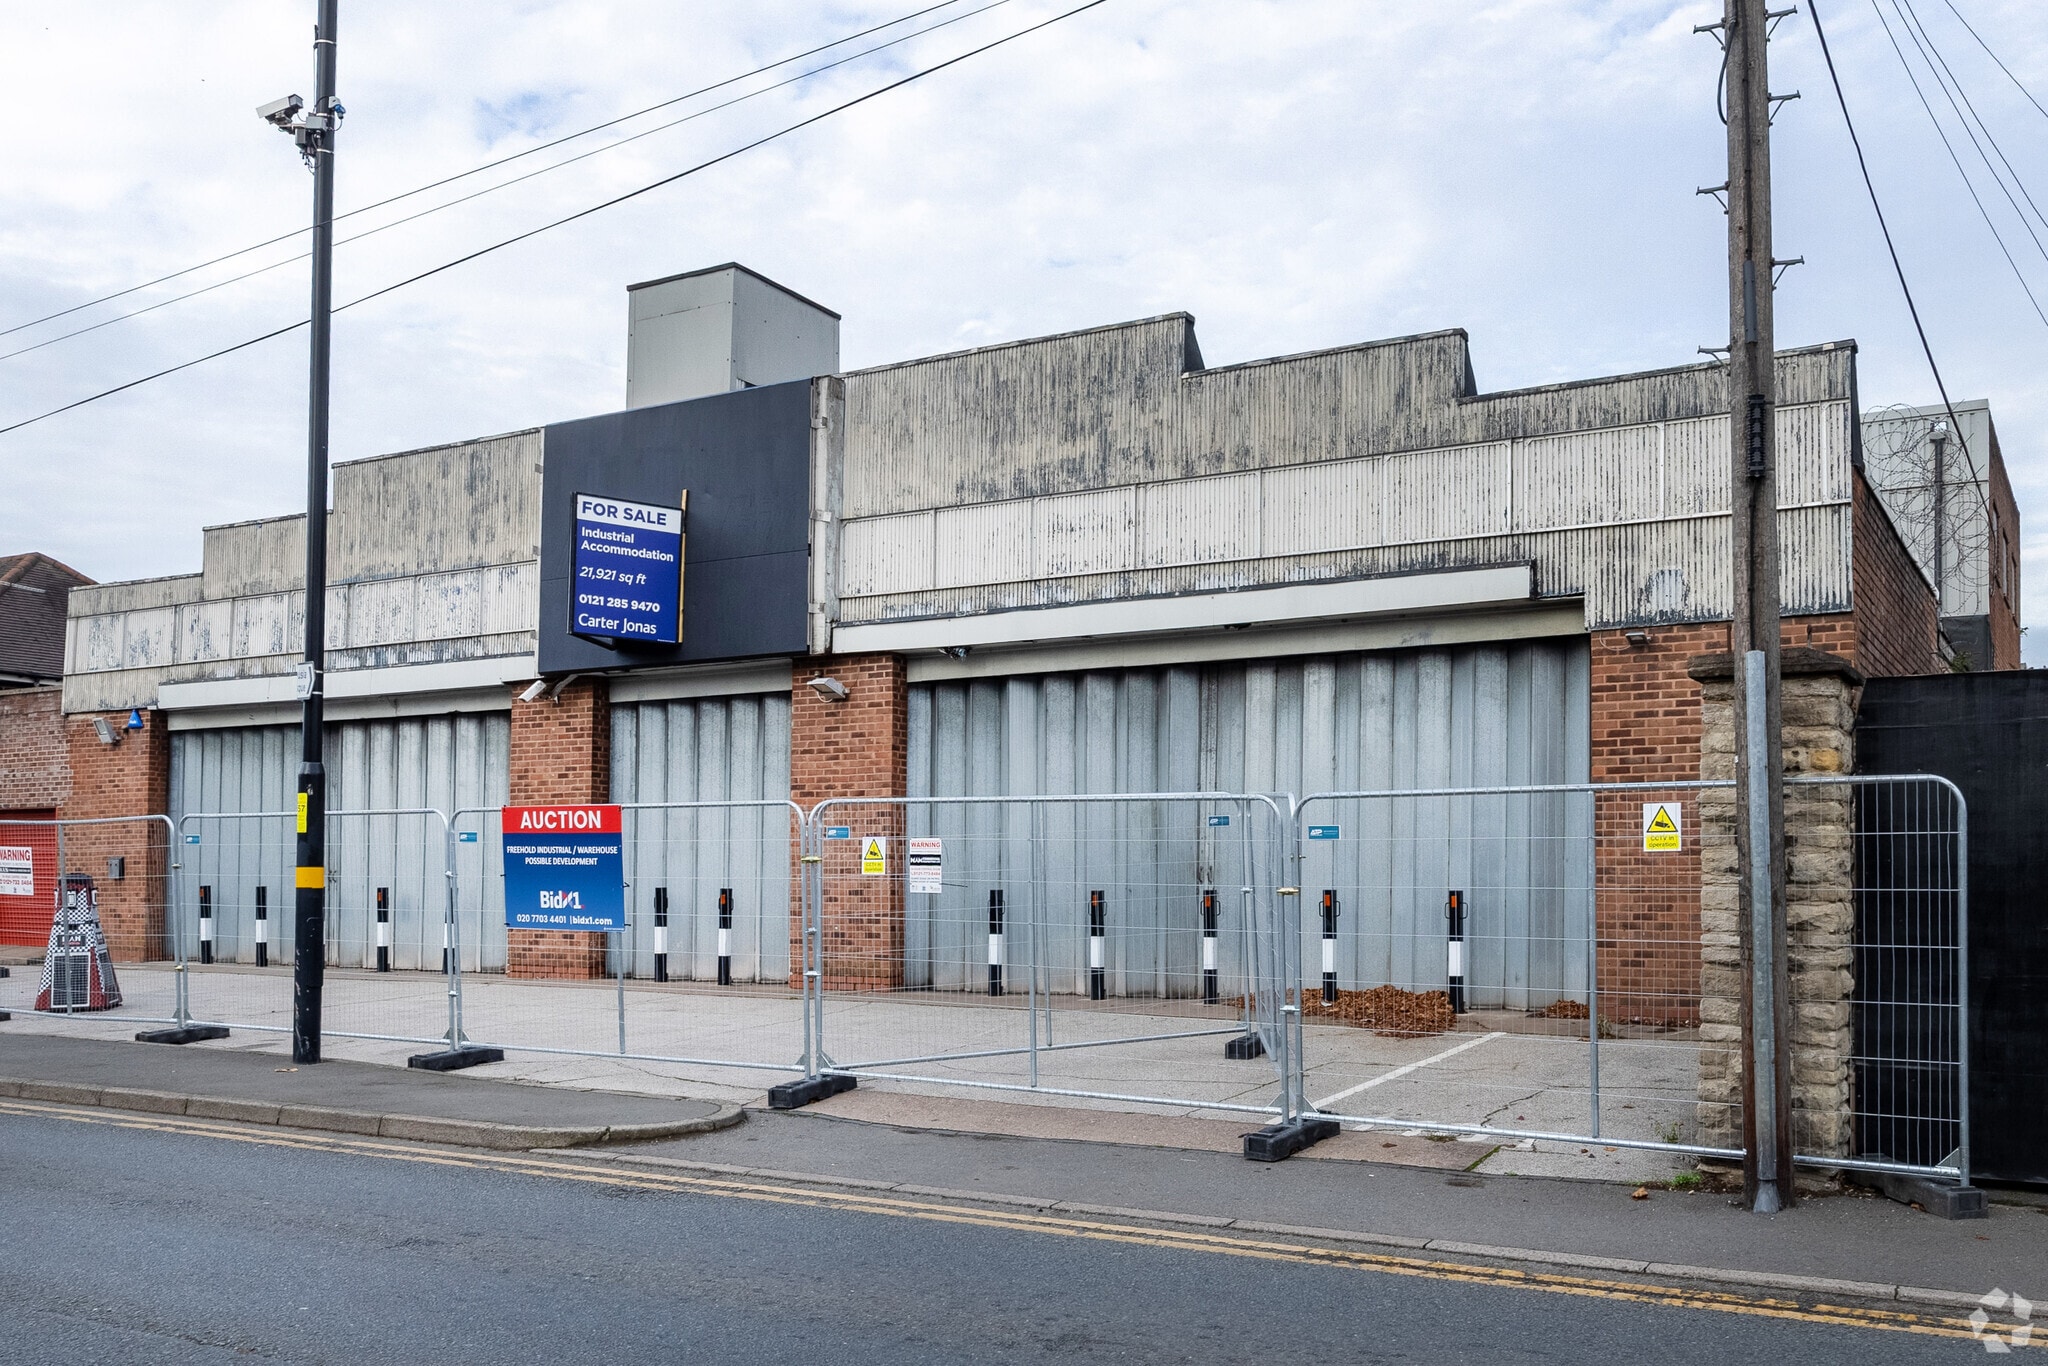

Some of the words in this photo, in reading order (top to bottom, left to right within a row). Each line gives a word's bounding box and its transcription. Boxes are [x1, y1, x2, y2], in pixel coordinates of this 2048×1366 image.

[582, 501, 618, 518] FOR
[623, 508, 667, 526] SALE
[581, 526, 634, 544] Industrial
[580, 540, 674, 562] Accommodation
[579, 566, 616, 581] 21,921
[618, 572, 634, 586] sq
[636, 574, 646, 584] ft
[578, 594, 604, 606] 0121
[606, 597, 628, 608] 285
[631, 600, 660, 612] 9470
[578, 613, 619, 630] Carter
[621, 618, 656, 634] Jonas
[520, 810, 601, 829] AUCTION
[506, 846, 537, 854] FREEHOLD
[537, 846, 572, 854] INDUSTRIAL
[577, 846, 618, 854] WAREHOUSE
[552, 857, 598, 865] DEVELOPMENT
[516, 914, 530, 922] 020
[531, 914, 548, 923] 7703
[549, 915, 566, 923] 4401
